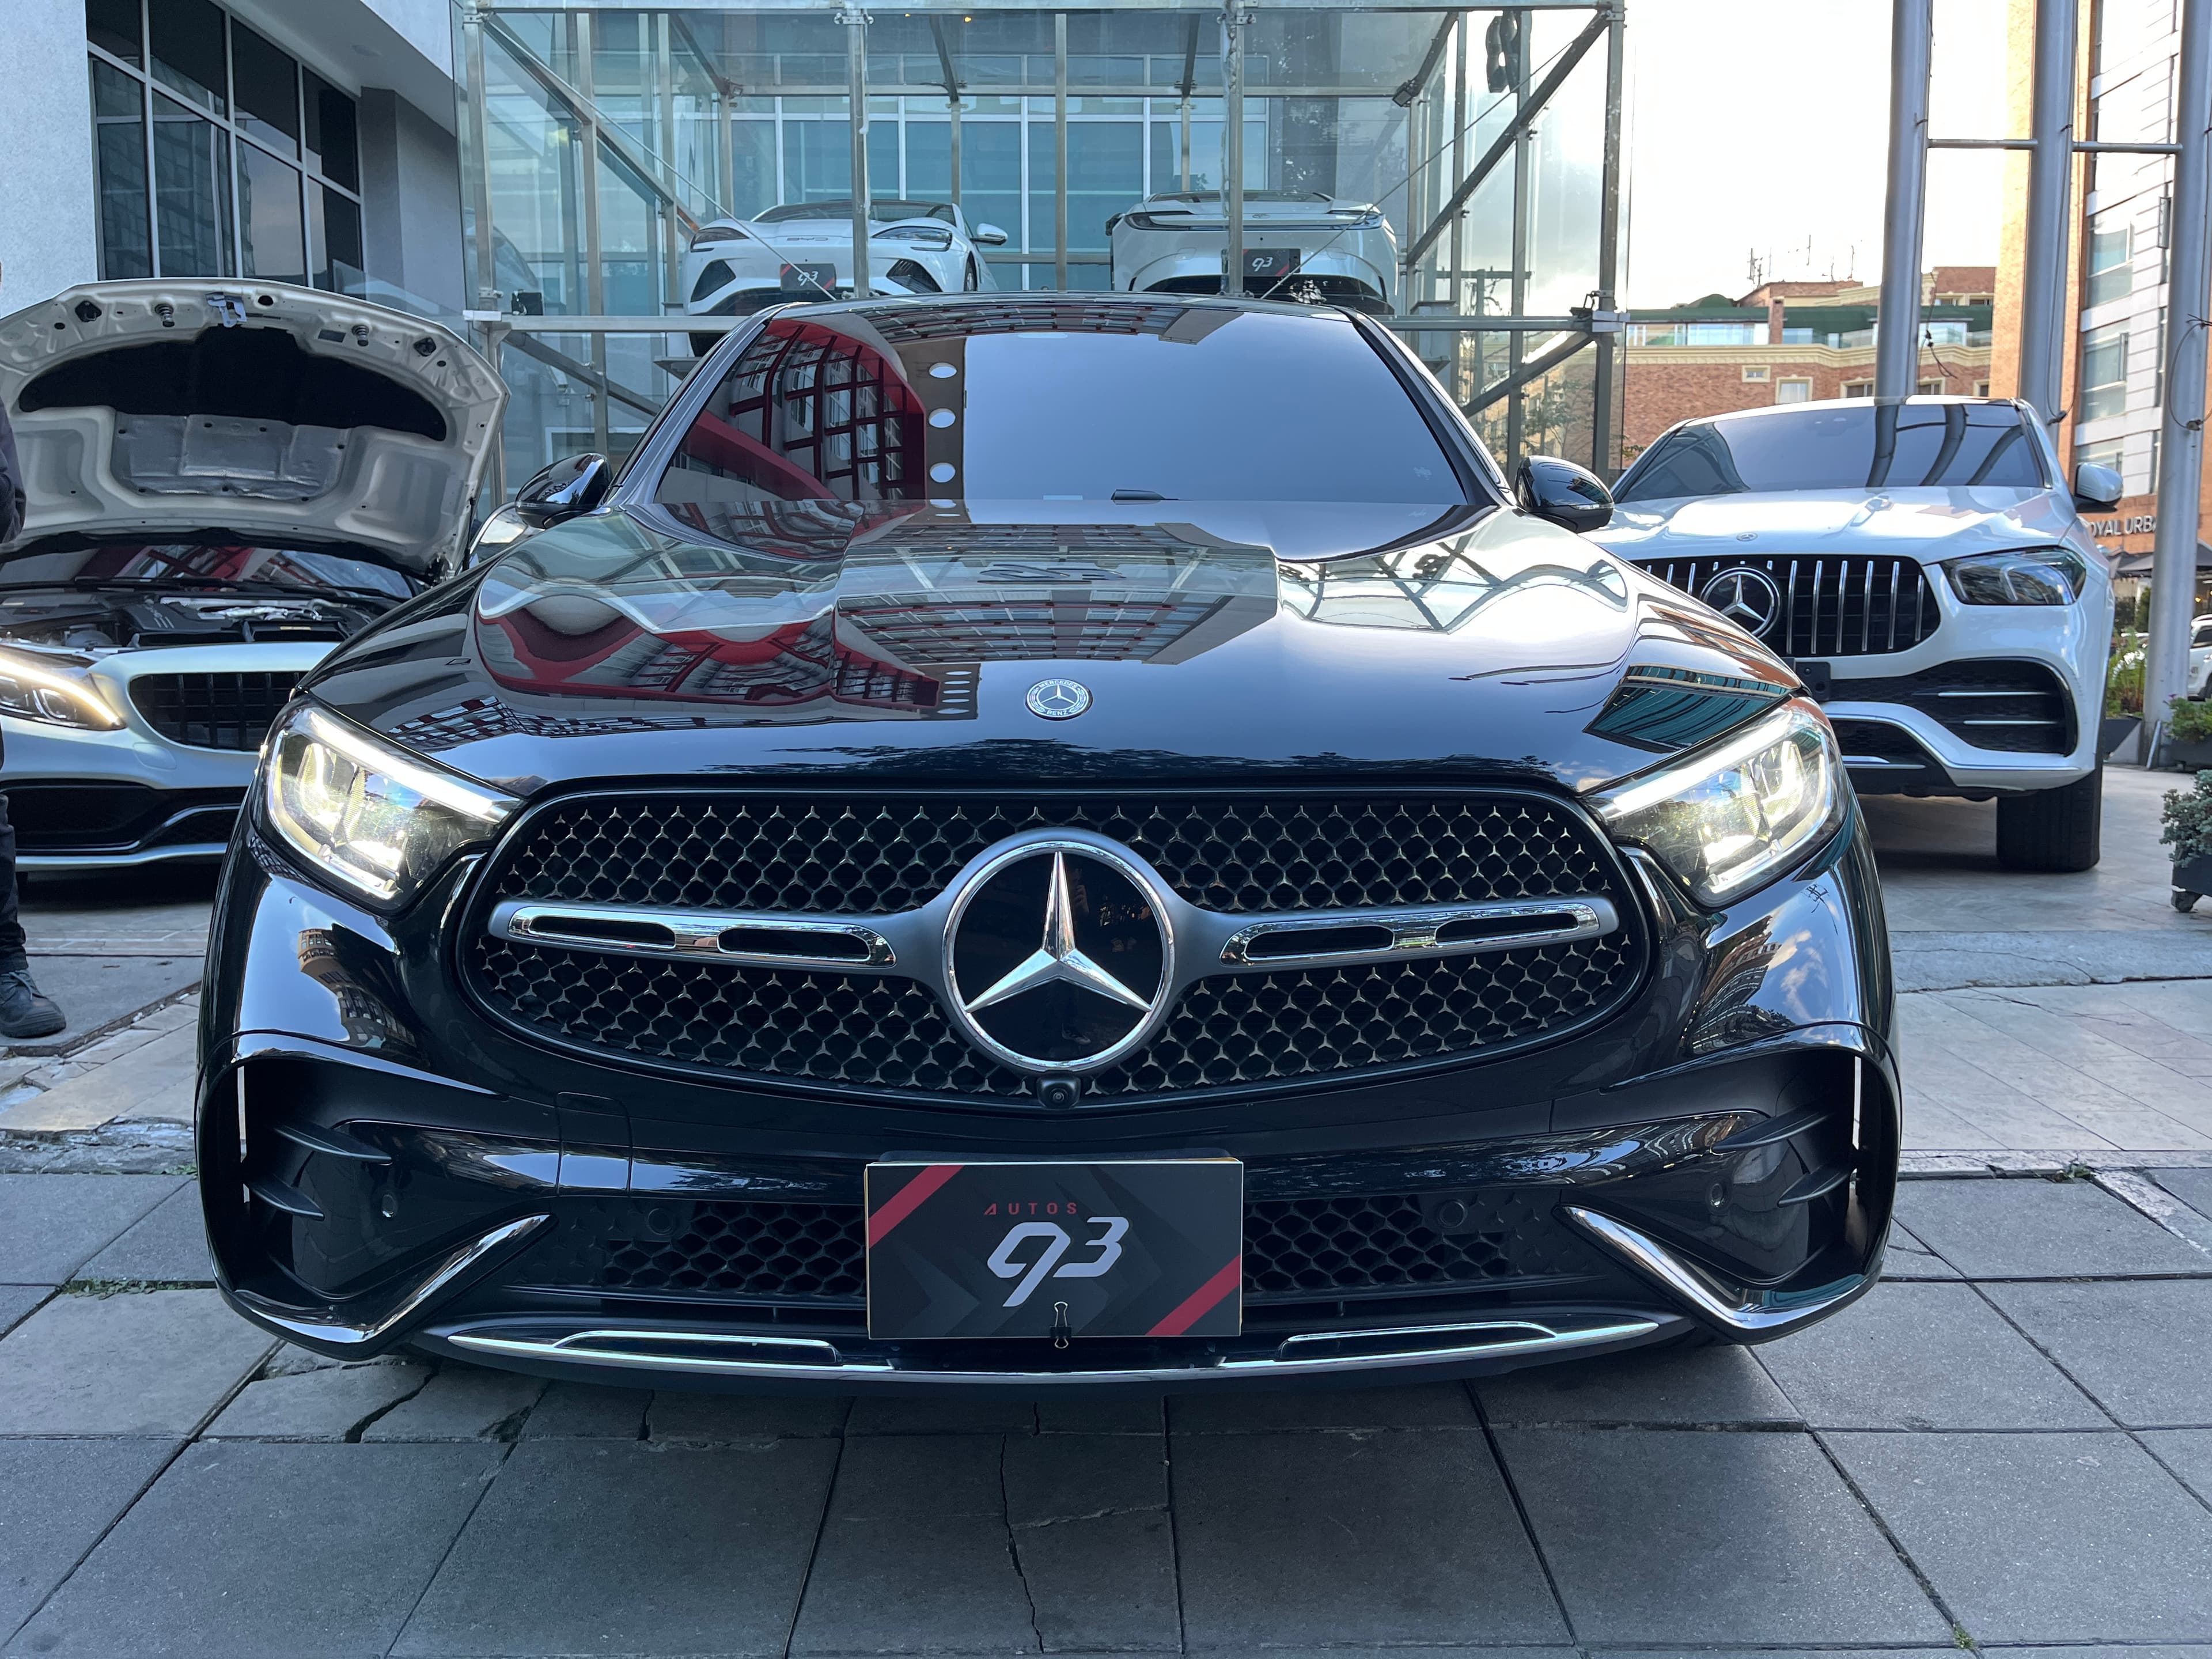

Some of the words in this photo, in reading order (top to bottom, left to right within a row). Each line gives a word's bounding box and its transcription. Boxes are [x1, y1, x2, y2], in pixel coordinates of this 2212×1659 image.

[1039, 680, 1078, 689] MERCEDES
[984, 1202, 1078, 1215] AUTOS
[987, 1217, 1129, 1307] 93
